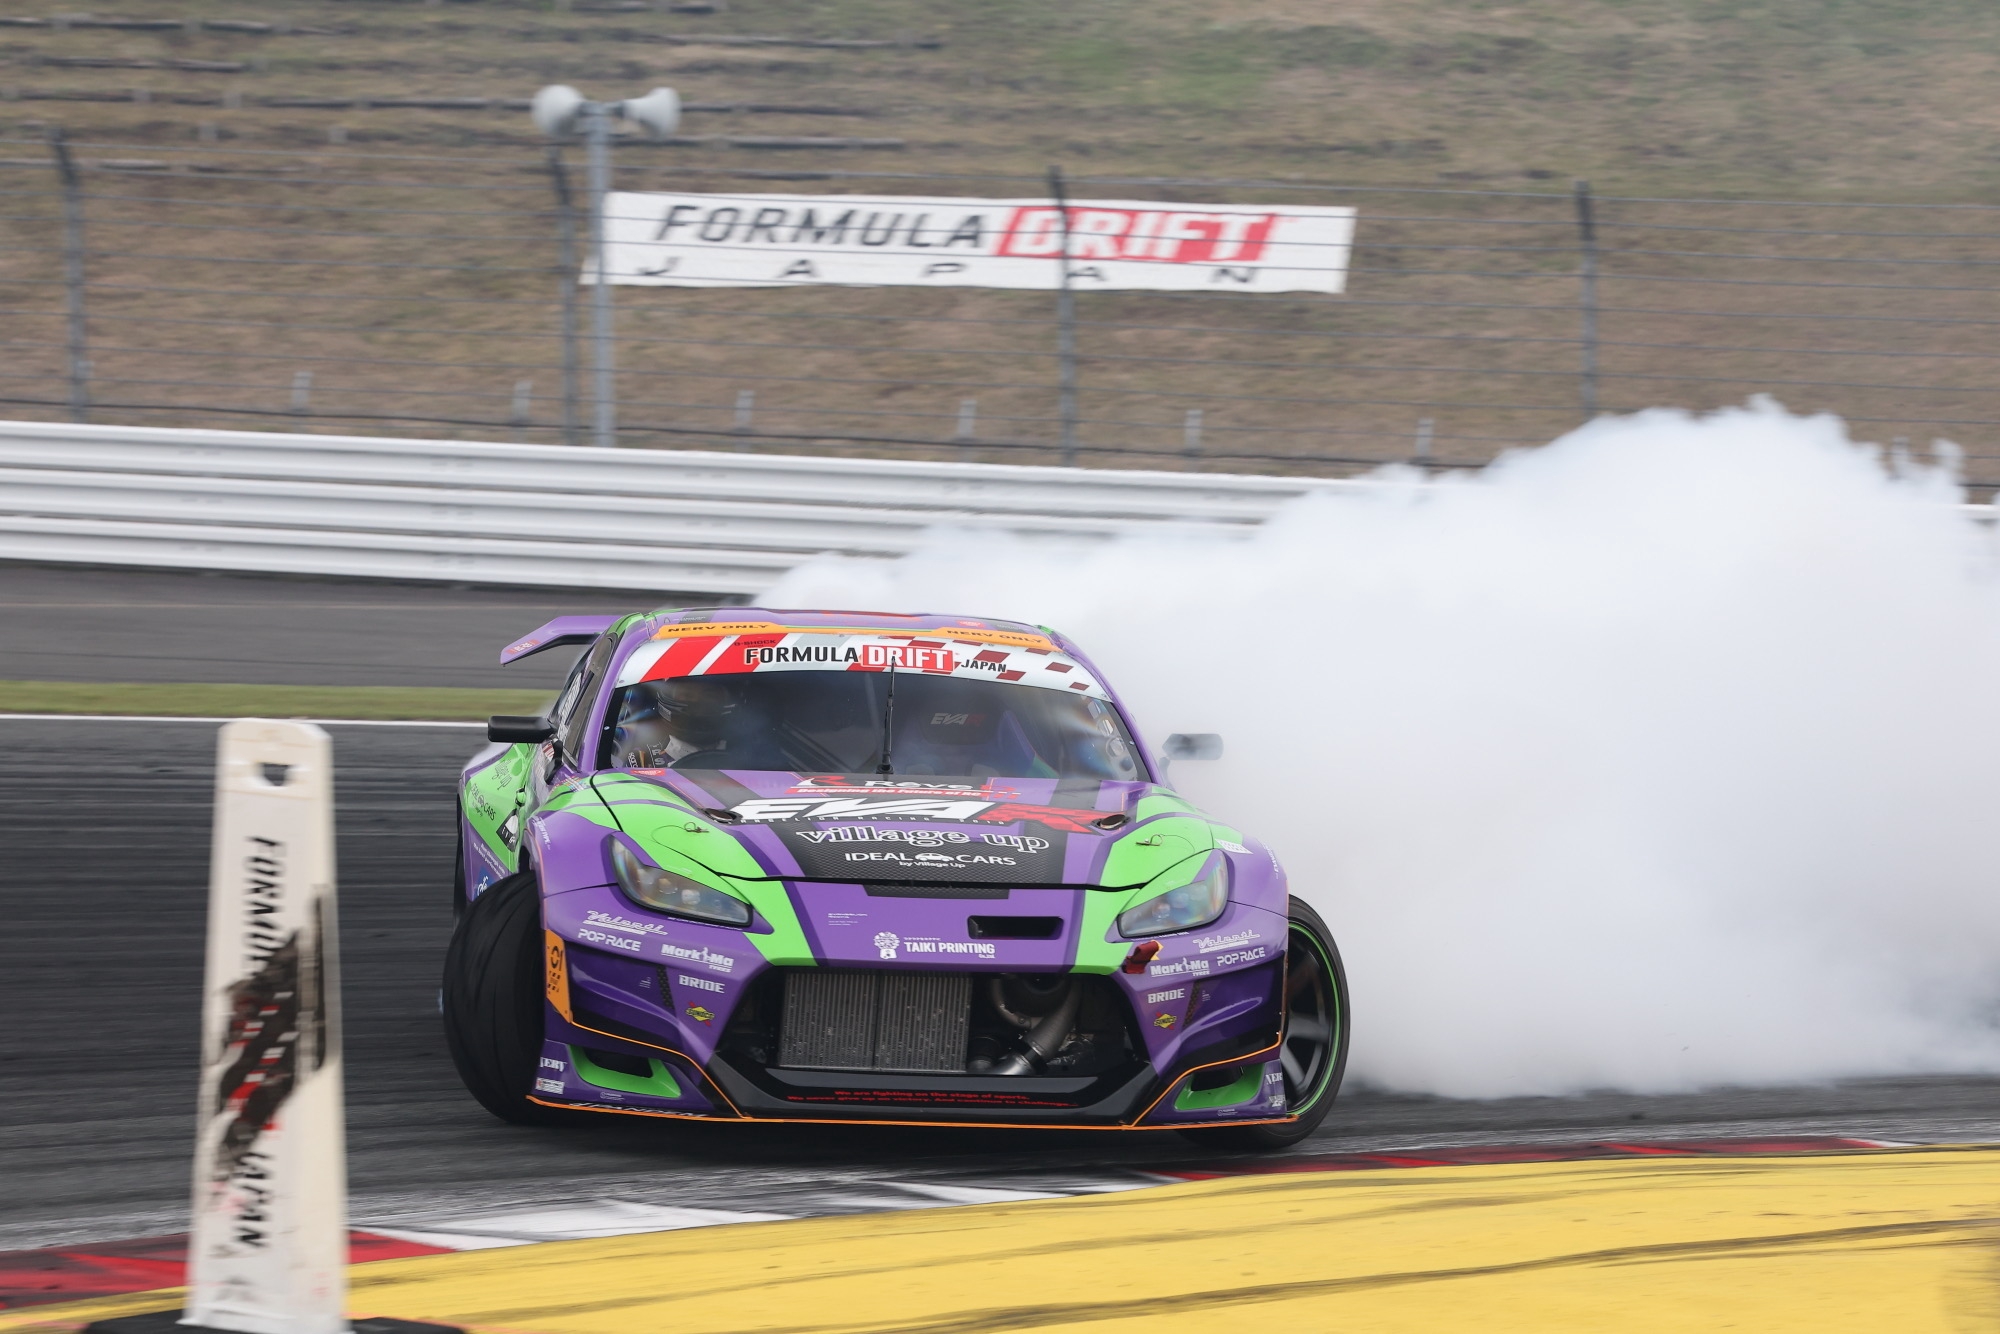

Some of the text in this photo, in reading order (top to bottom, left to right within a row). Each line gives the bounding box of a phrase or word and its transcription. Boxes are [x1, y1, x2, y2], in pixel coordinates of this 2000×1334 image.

[654, 204, 1262, 261] FORMULA DRIFT
[637, 255, 1256, 284] JAPAN
[998, 634, 1042, 643] ONLY
[745, 645, 1007, 673] FORMULA DRIFT JAPAN
[795, 825, 1050, 853] village up
[844, 852, 1017, 866] IDEAL CARS
[903, 941, 996, 955] TAIKI PRINTING
[678, 974, 726, 994] BRIDE
[1147, 988, 1186, 1004] BRIDE
